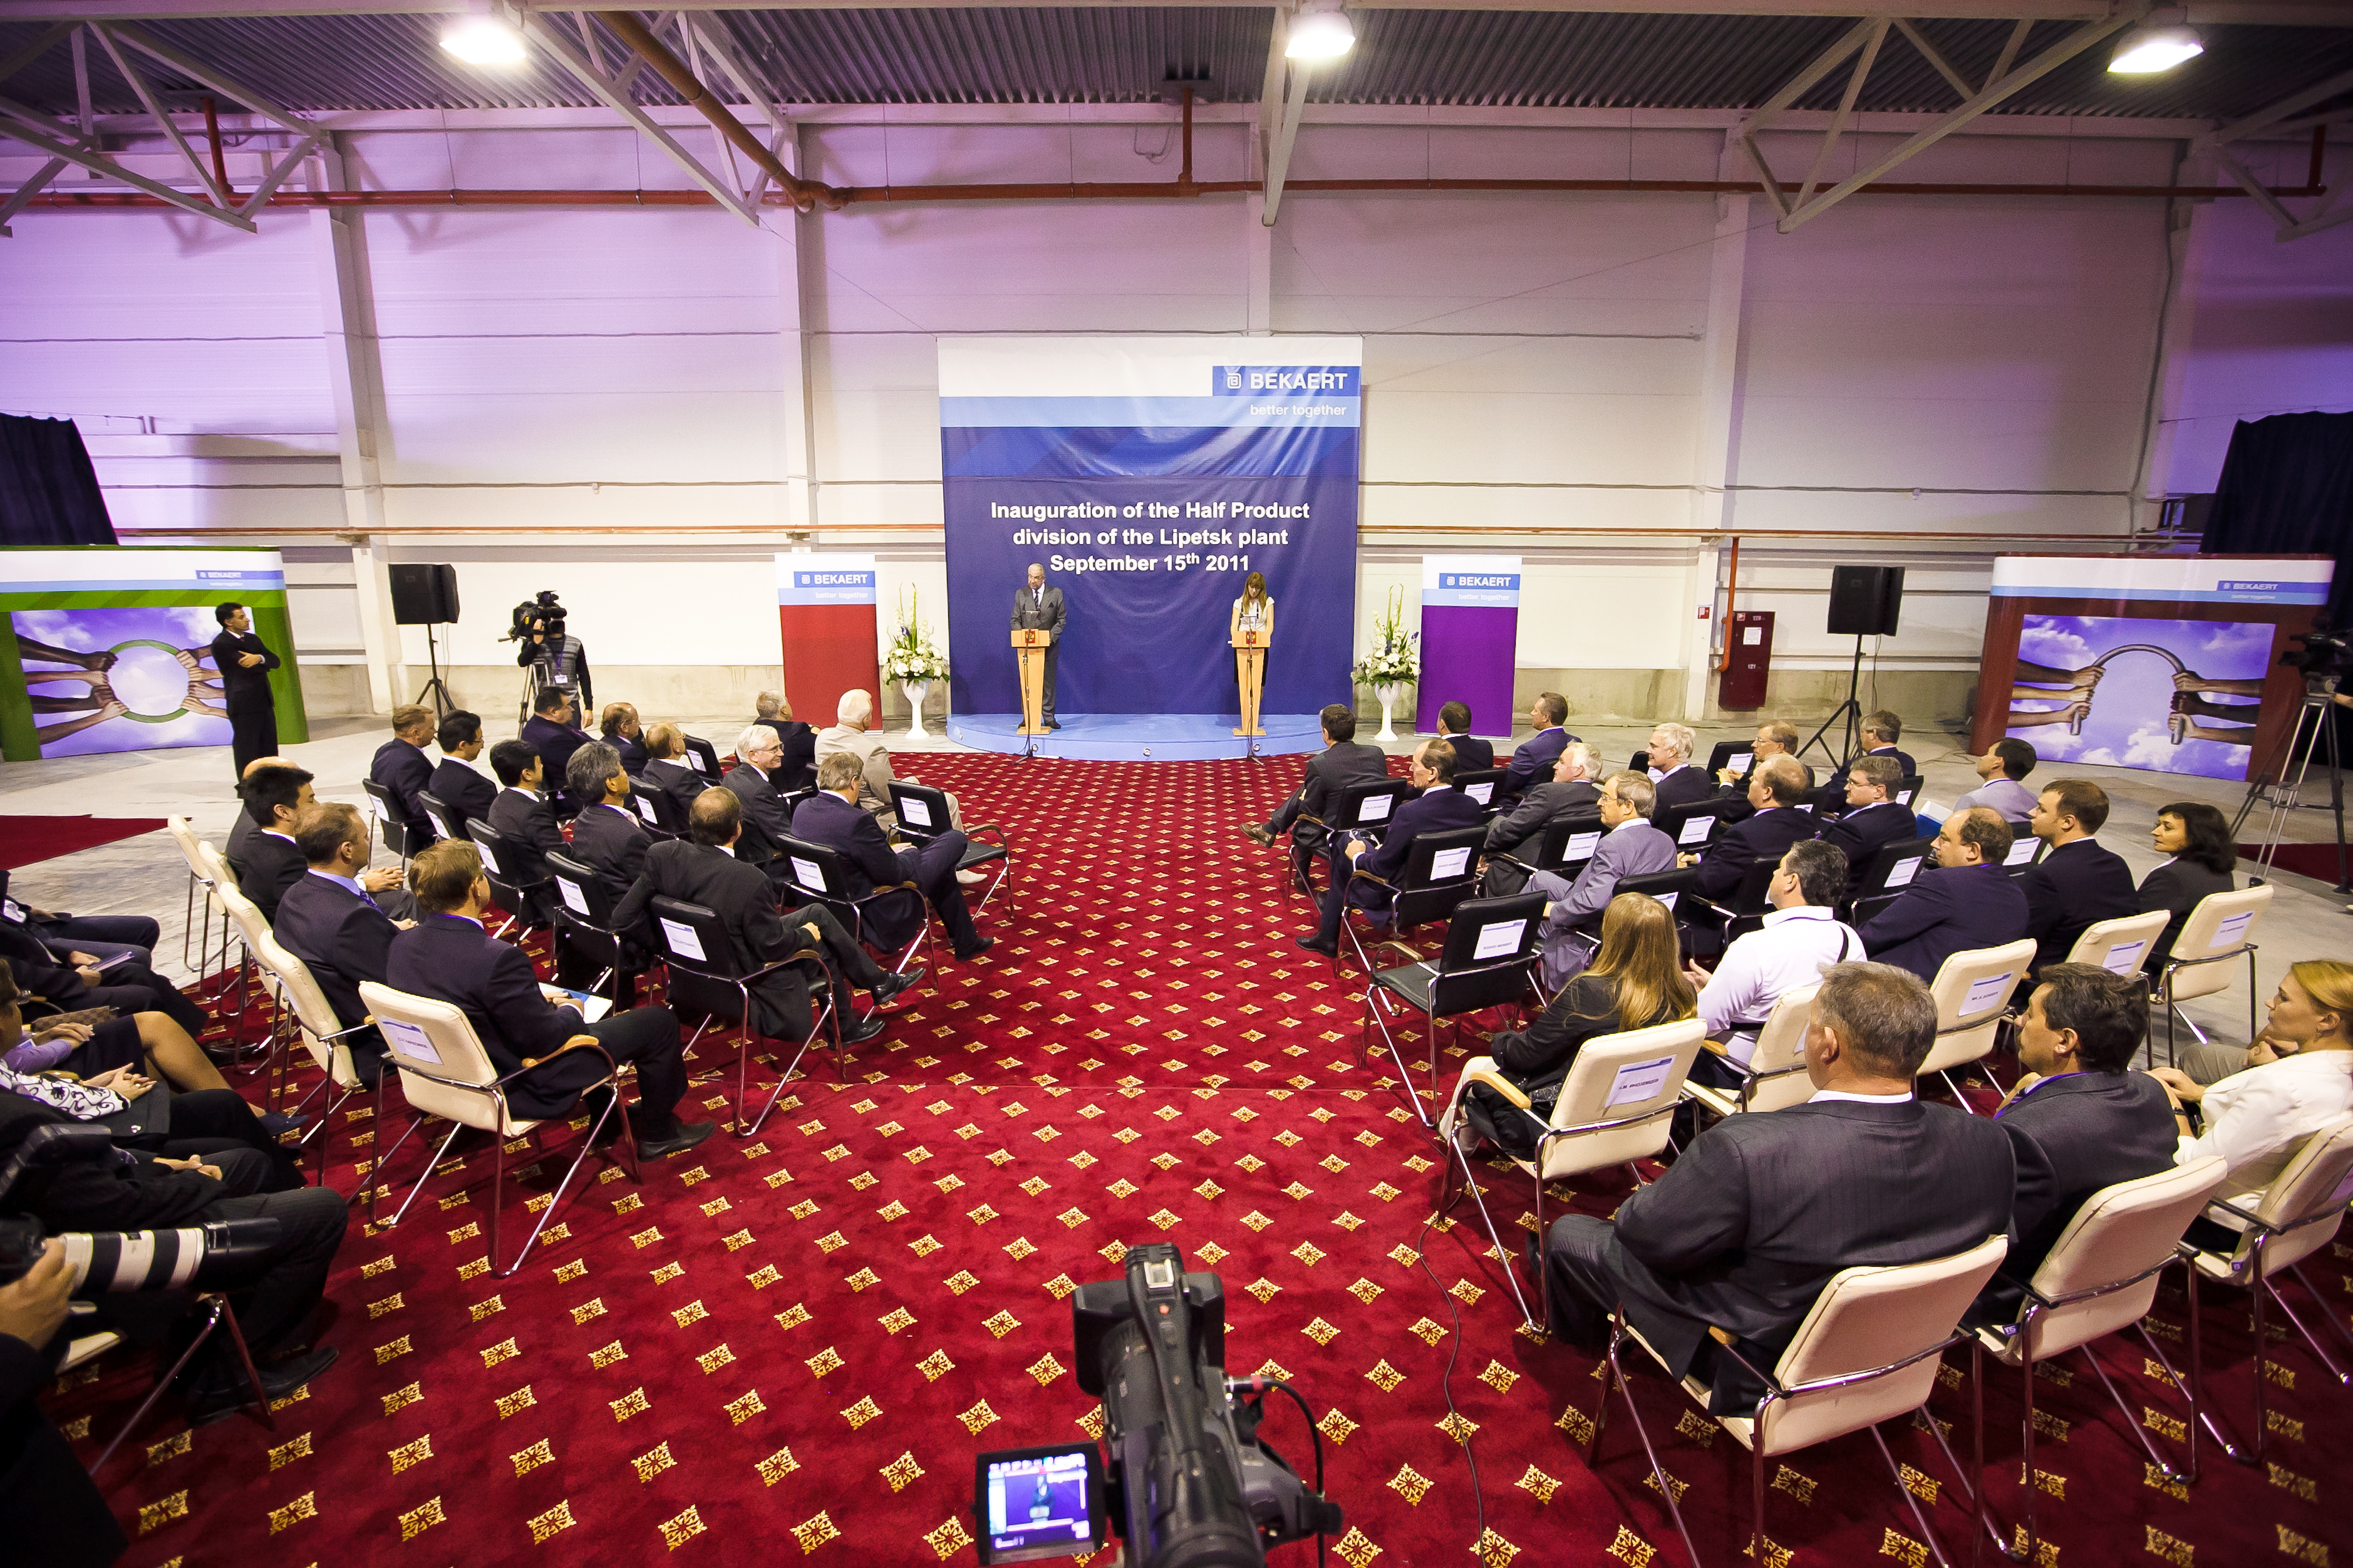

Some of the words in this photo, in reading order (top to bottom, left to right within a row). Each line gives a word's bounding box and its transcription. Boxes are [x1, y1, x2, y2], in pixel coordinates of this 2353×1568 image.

[1250, 373, 1348, 389] BEKAERT
[1250, 404, 1288, 416] better
[1292, 404, 1347, 418] together
[991, 502, 1117, 522] Inauguration
[1123, 502, 1144, 518] of
[1147, 502, 1180, 518] the
[1186, 502, 1226, 518] Half
[1231, 502, 1310, 518] Product
[1013, 528, 1091, 545] division
[1097, 528, 1118, 545] of
[1122, 528, 1154, 545] the
[1160, 529, 1233, 549] Lipetsk
[1238, 529, 1288, 549] plant
[1050, 554, 1159, 575] September
[1164, 552, 1200, 571] 15th
[1206, 555, 1248, 571] 2011
[814, 574, 868, 584] BEKAERT
[1459, 576, 1512, 587] BEKAERT
[839, 592, 869, 600] together
